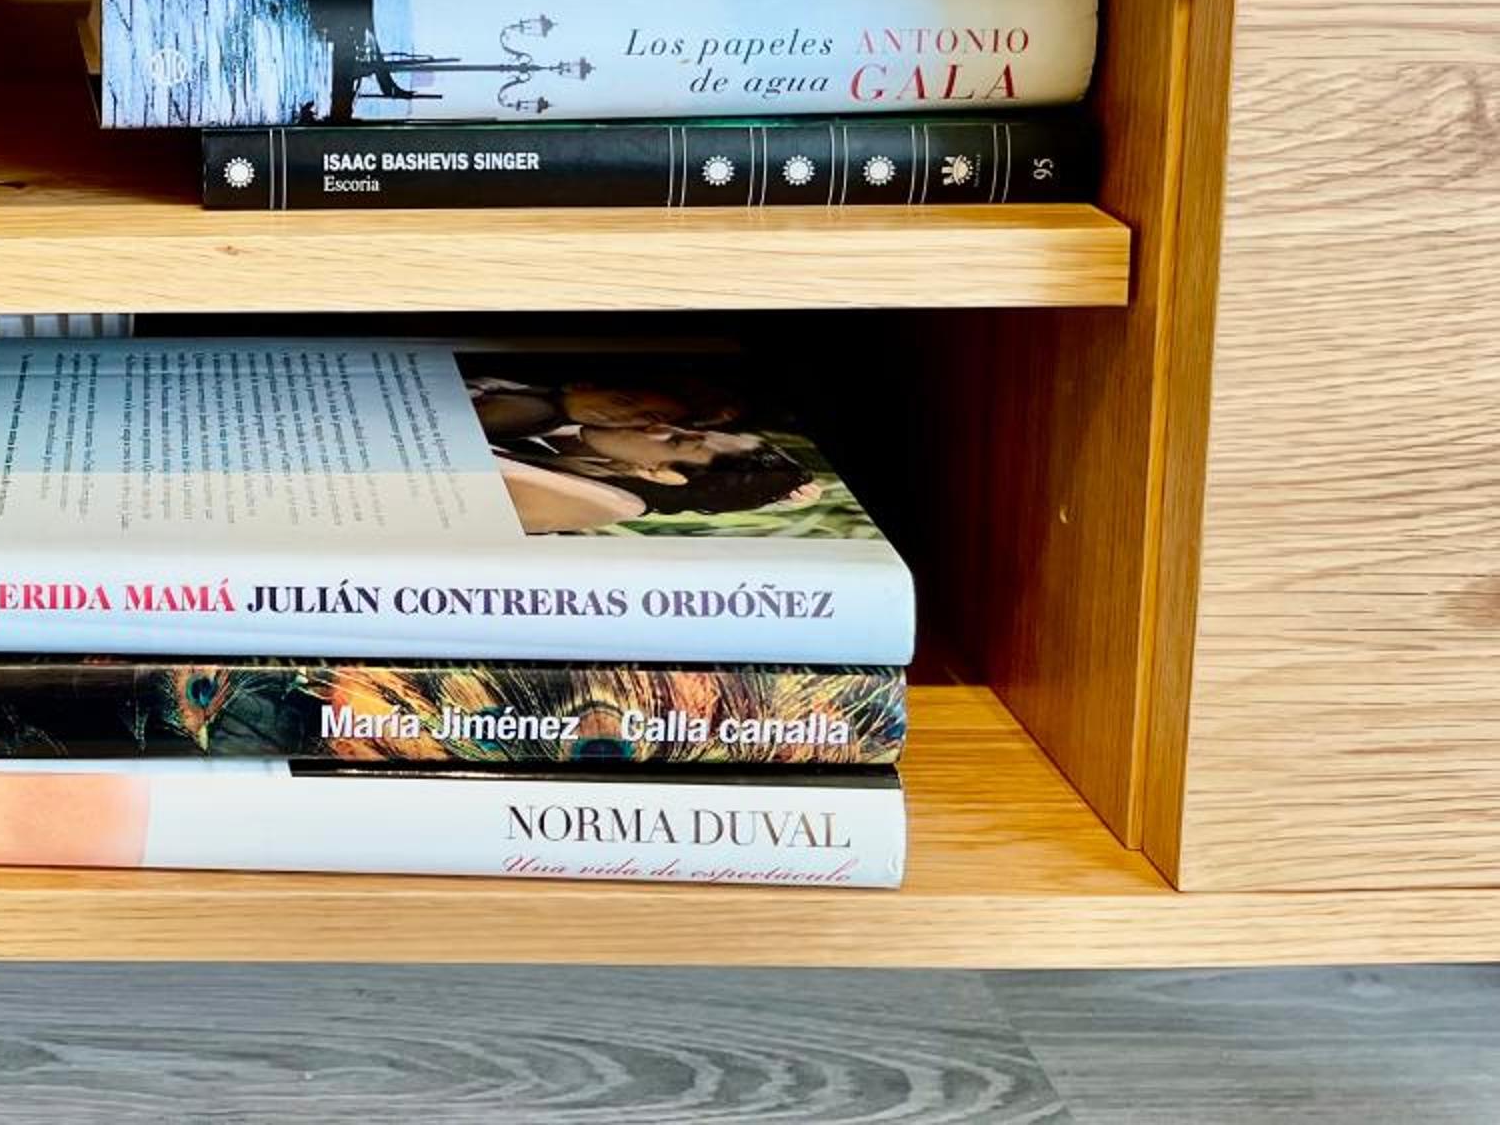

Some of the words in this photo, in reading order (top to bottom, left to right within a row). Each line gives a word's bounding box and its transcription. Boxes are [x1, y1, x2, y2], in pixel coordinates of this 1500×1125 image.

[624, 28, 685, 57] Los
[697, 28, 834, 65] papeles
[855, 27, 1030, 54] ANTONIO
[689, 67, 730, 94] de
[743, 74, 831, 100] agua
[849, 62, 1023, 100] GALA
[323, 153, 377, 171] ISAAC
[381, 152, 469, 171] BASHEVIS
[473, 152, 540, 170] SINGER
[323, 174, 380, 192] Escoria
[124, 577, 236, 613] MAMÁ
[247, 578, 380, 615] JULIÁN
[393, 586, 628, 618] CONTRERAS
[641, 582, 835, 619] ORDÓÑEZ
[320, 705, 420, 741] María
[432, 705, 581, 742] Jiménez
[621, 709, 708, 744] Calla
[718, 711, 851, 746] canalla
[506, 804, 680, 844] NORMA
[689, 809, 852, 849] DUVAL
[502, 855, 566, 873] Una
[580, 857, 641, 875] vida
[650, 859, 682, 878] de
